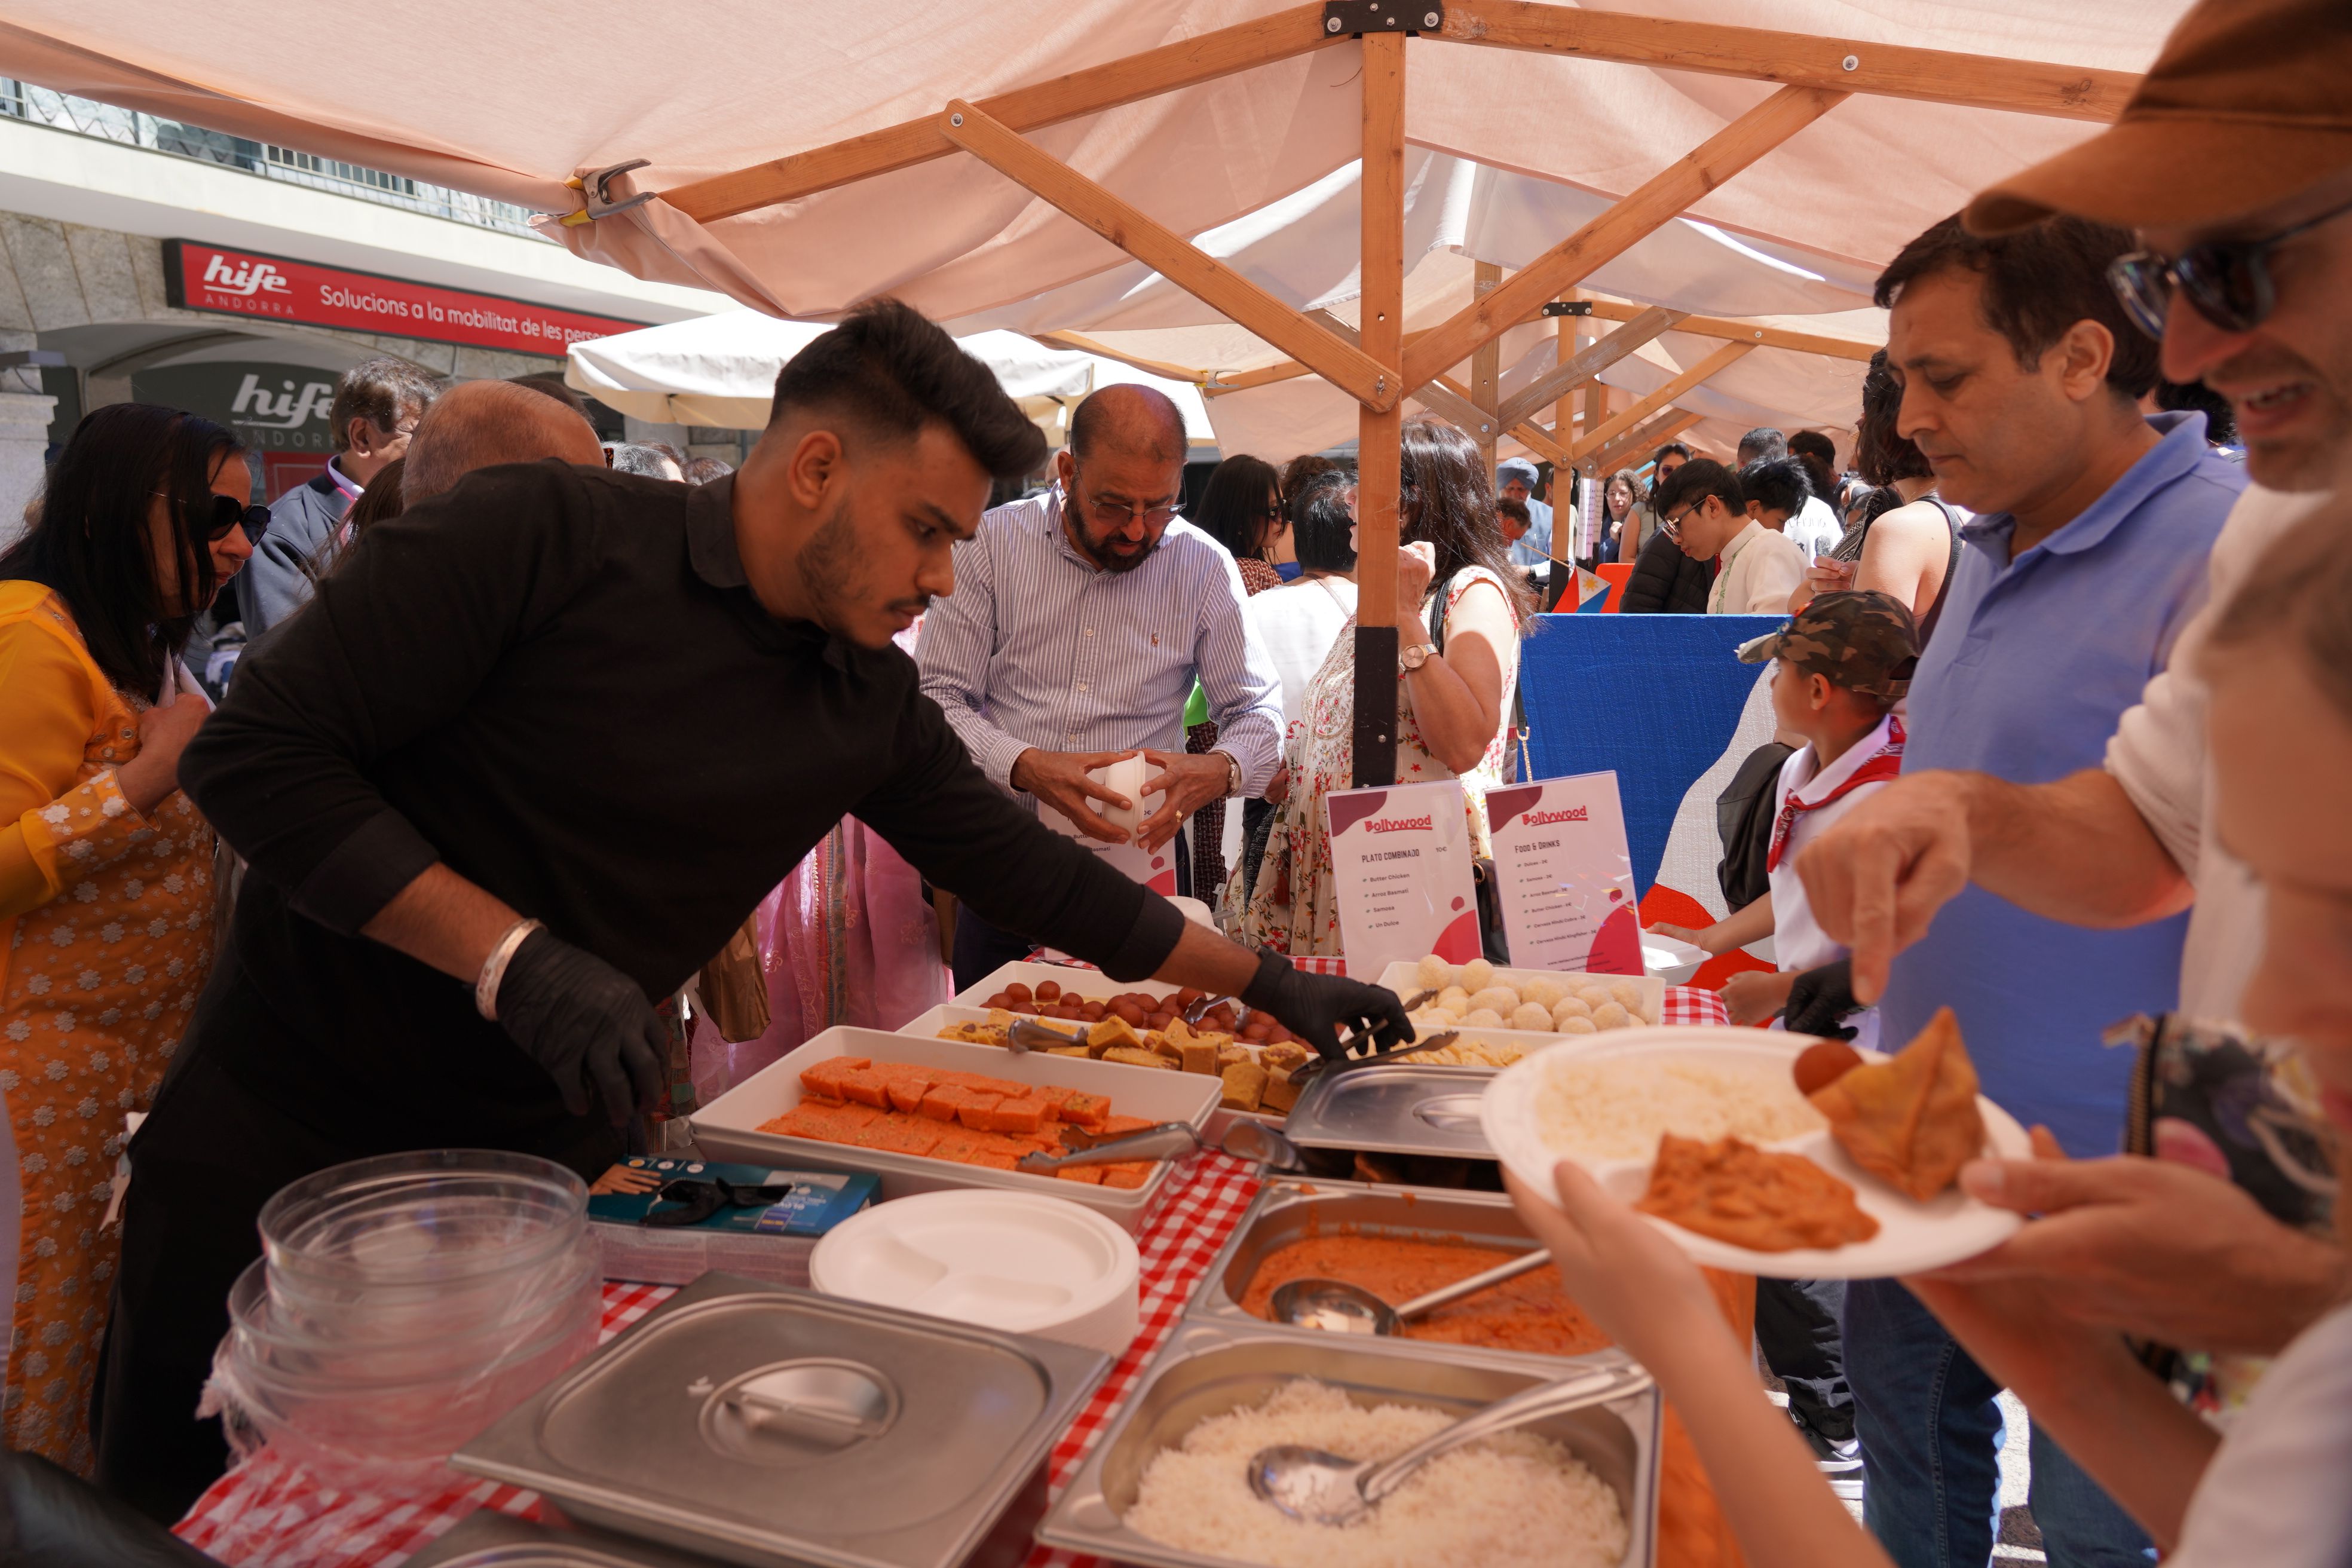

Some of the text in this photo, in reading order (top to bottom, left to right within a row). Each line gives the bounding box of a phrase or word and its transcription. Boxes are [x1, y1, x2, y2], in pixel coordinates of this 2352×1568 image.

[203, 254, 293, 295] hife
[205, 293, 295, 316] ANDORRA
[320, 284, 409, 317] Solucions
[411, 303, 424, 319] a
[427, 301, 445, 322] la
[447, 308, 519, 334] mobilitat
[520, 317, 540, 337] de
[543, 320, 562, 341] les
[1364, 814, 1432, 832] Bollywood
[1522, 806, 1588, 825] Bollywood
[1362, 853, 1383, 863] PLATO
[1384, 849, 1420, 860] COMBINADO
[1532, 843, 1537, 851] &
[1387, 887, 1409, 896] Basmati
